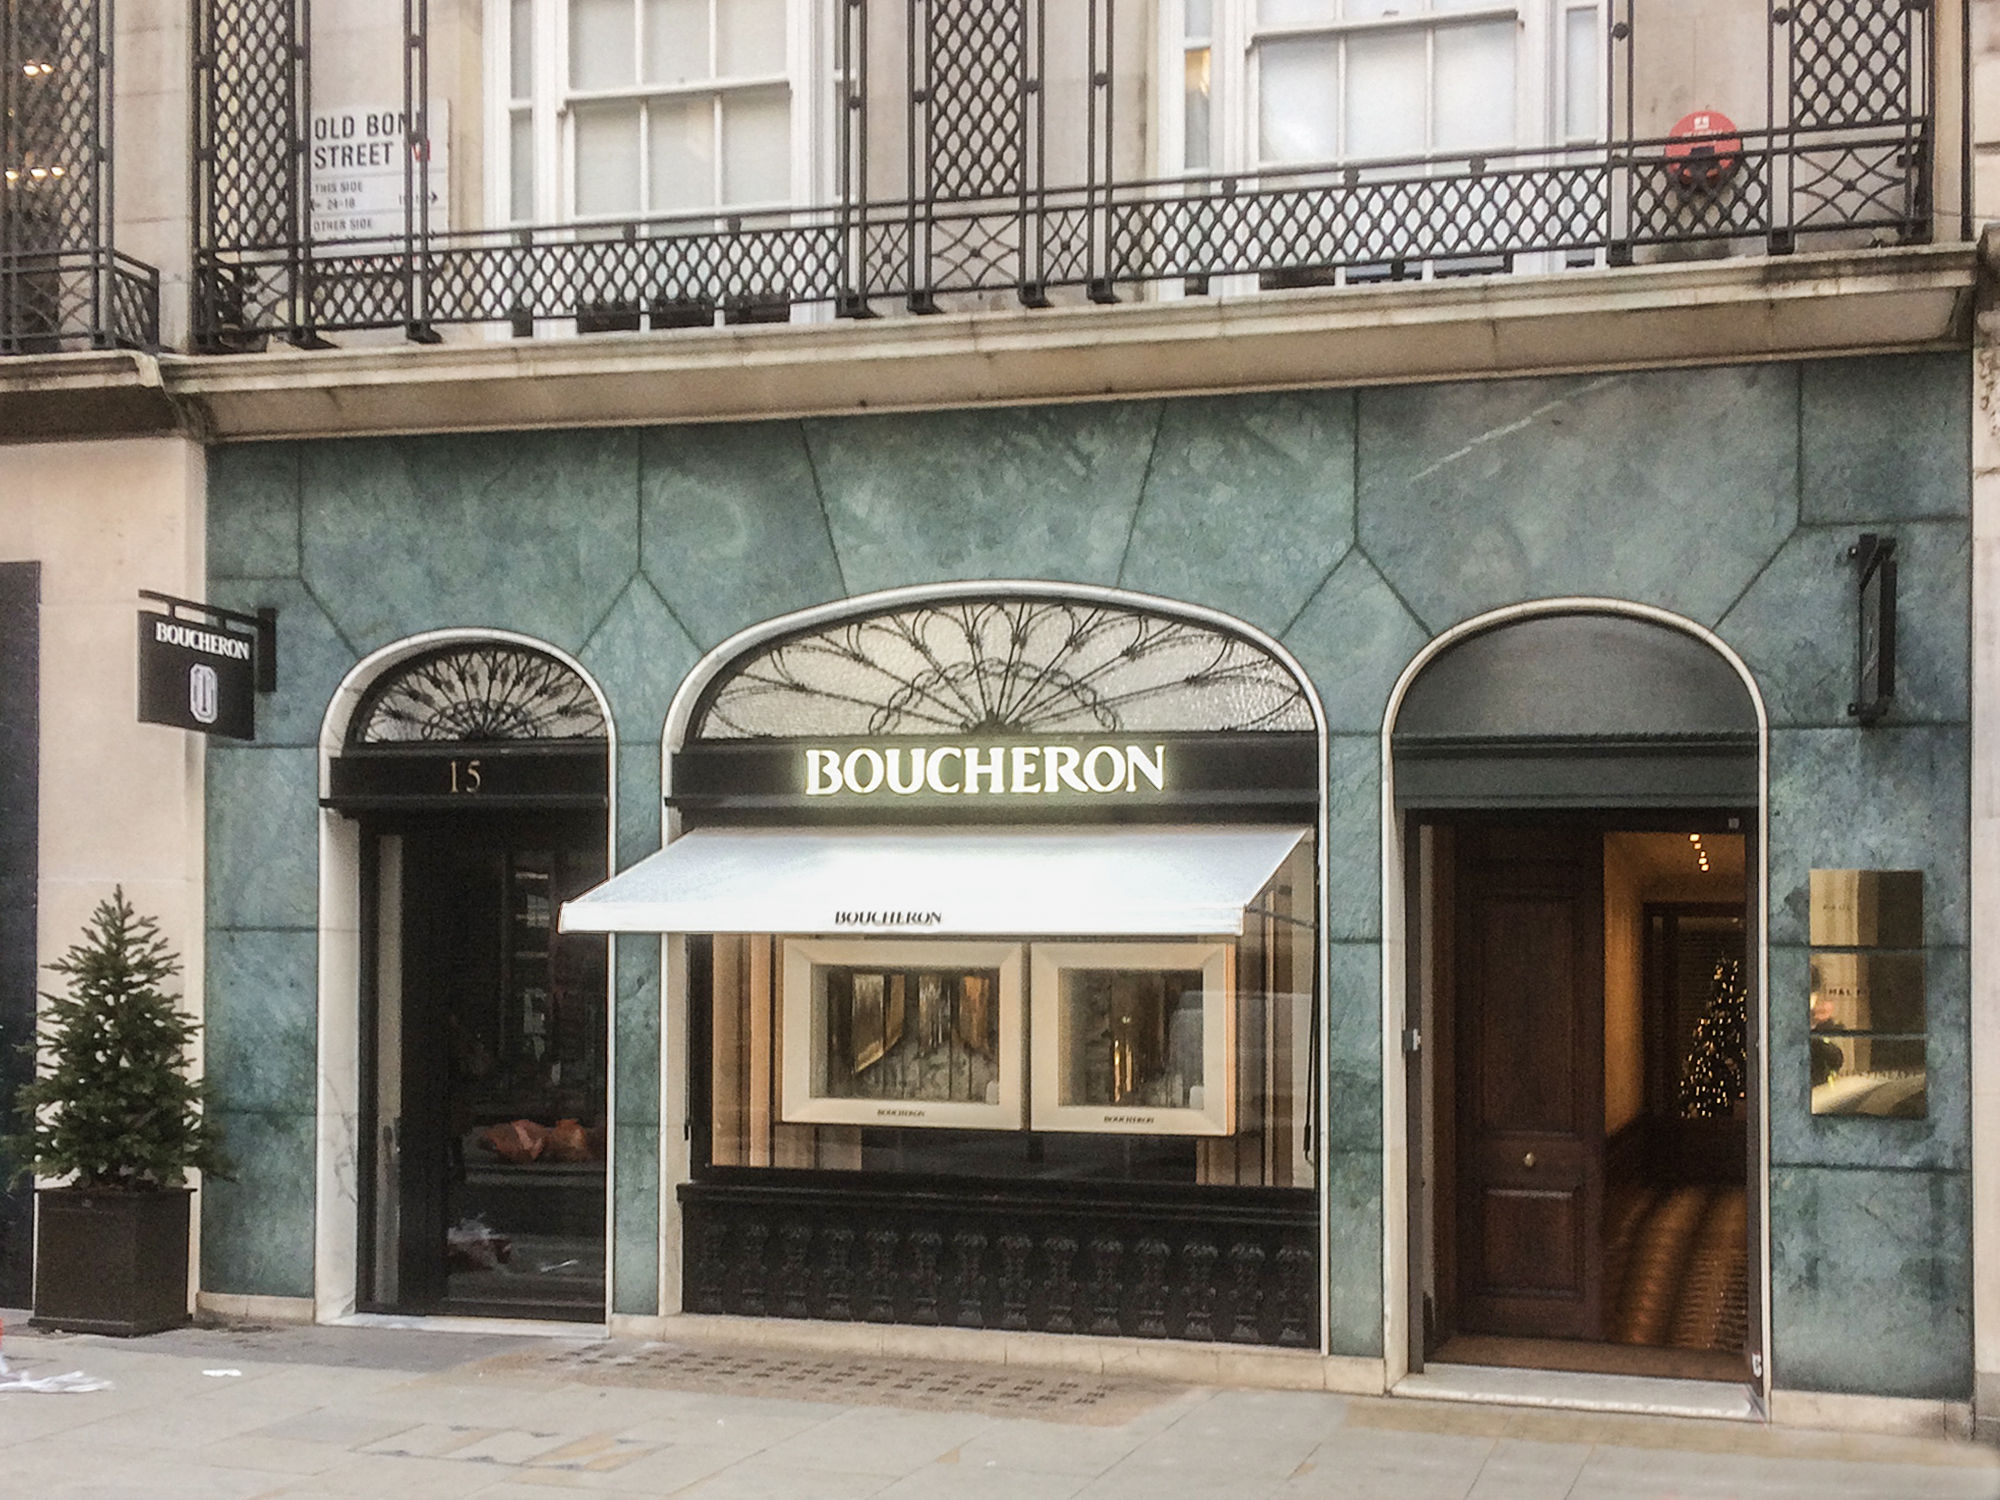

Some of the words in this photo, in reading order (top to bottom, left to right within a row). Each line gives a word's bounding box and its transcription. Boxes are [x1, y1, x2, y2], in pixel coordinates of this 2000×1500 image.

[314, 115, 355, 141] OLD
[313, 142, 394, 170] STREET
[314, 182, 338, 194] THIS
[340, 181, 363, 193] SIDE
[155, 621, 250, 660] BOUCHERON
[449, 759, 482, 794] 15
[805, 744, 1167, 796] BOUCHERON
[834, 910, 943, 926] BOUCHERON
